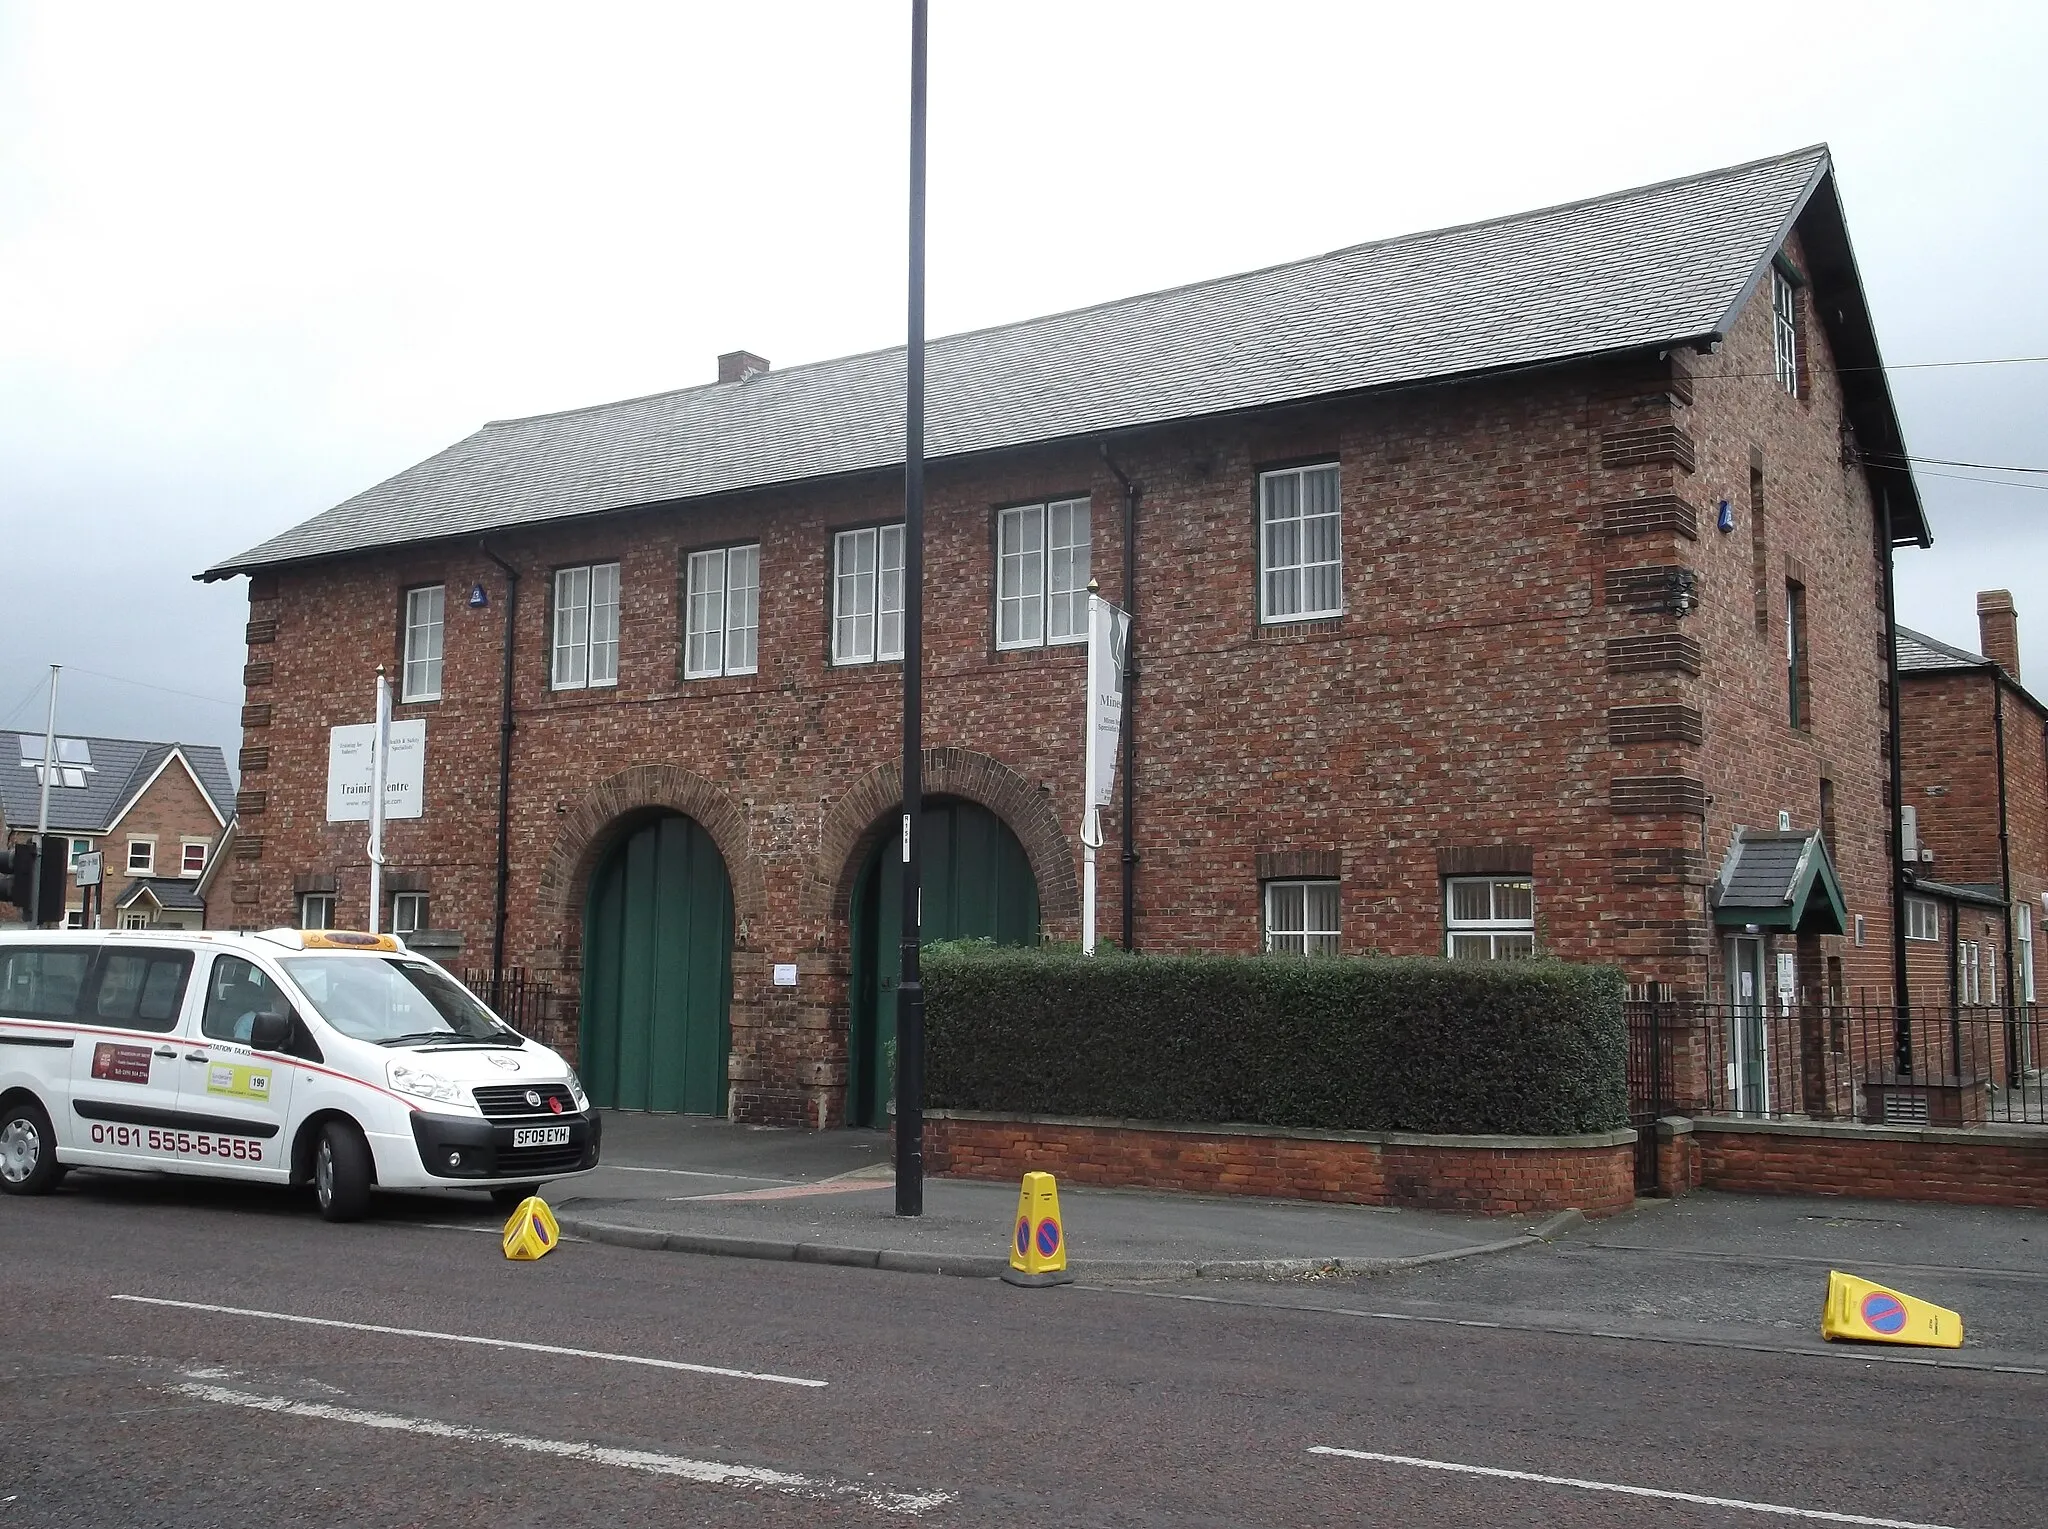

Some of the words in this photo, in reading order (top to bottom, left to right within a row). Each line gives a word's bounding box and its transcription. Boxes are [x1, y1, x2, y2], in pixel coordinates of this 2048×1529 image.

[341, 783, 371, 794] Trainin
[387, 782, 409, 792] entre
[208, 1043, 232, 1053] STATION
[233, 1047, 252, 1057] TAXIS
[252, 1077, 265, 1088] 199
[91, 1124, 141, 1148] 0191
[148, 1129, 262, 1162] 555-5-555
[517, 1129, 545, 1144] SF09
[547, 1128, 567, 1142] EYH
